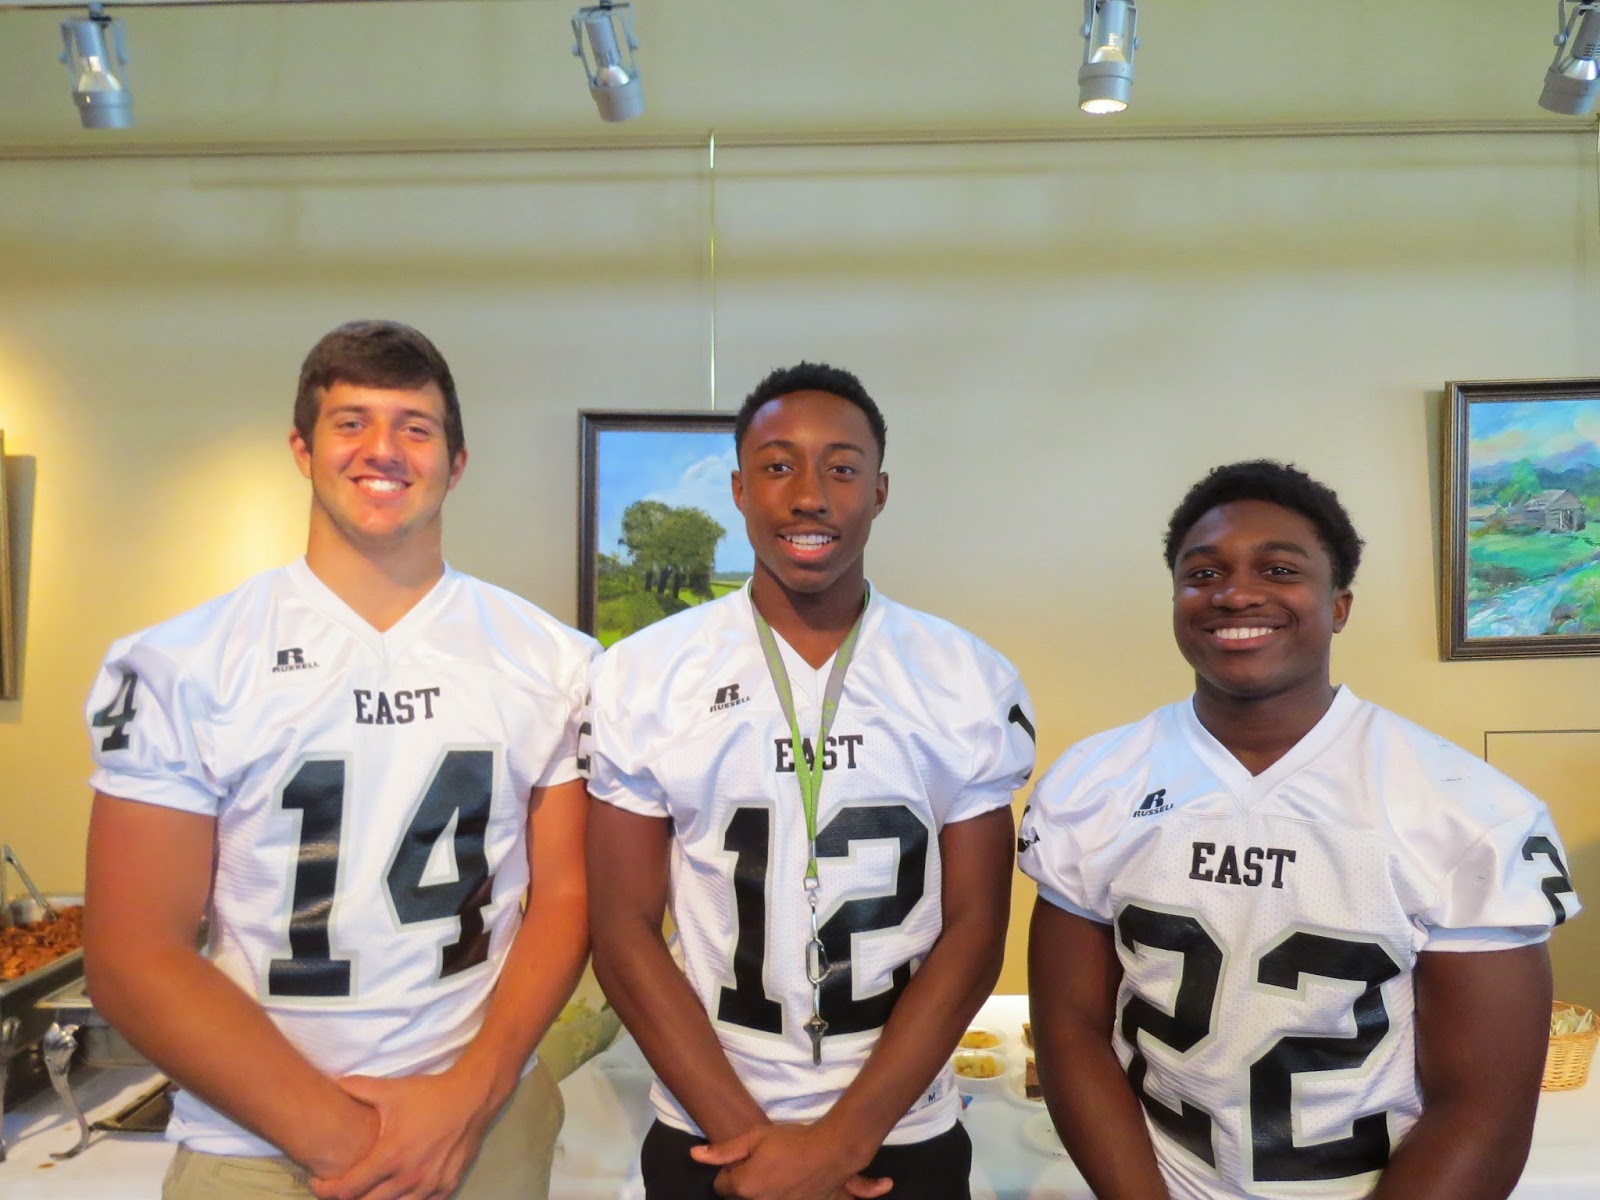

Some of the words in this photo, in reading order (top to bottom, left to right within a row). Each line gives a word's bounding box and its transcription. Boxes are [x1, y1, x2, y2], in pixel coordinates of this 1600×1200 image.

[272, 661, 320, 673] RUSSELL
[277, 647, 305, 665] R
[92, 667, 138, 752] 4
[353, 687, 440, 725] EAST
[709, 696, 751, 713] RUSSELL
[714, 683, 740, 704] R
[774, 734, 863, 772] EAST
[1132, 803, 1174, 818] RUSSELL
[1139, 788, 1167, 810] R
[266, 747, 497, 996] 14
[1189, 841, 1297, 889] EAST
[714, 803, 932, 1038] 12
[1115, 902, 1402, 1185] 22
